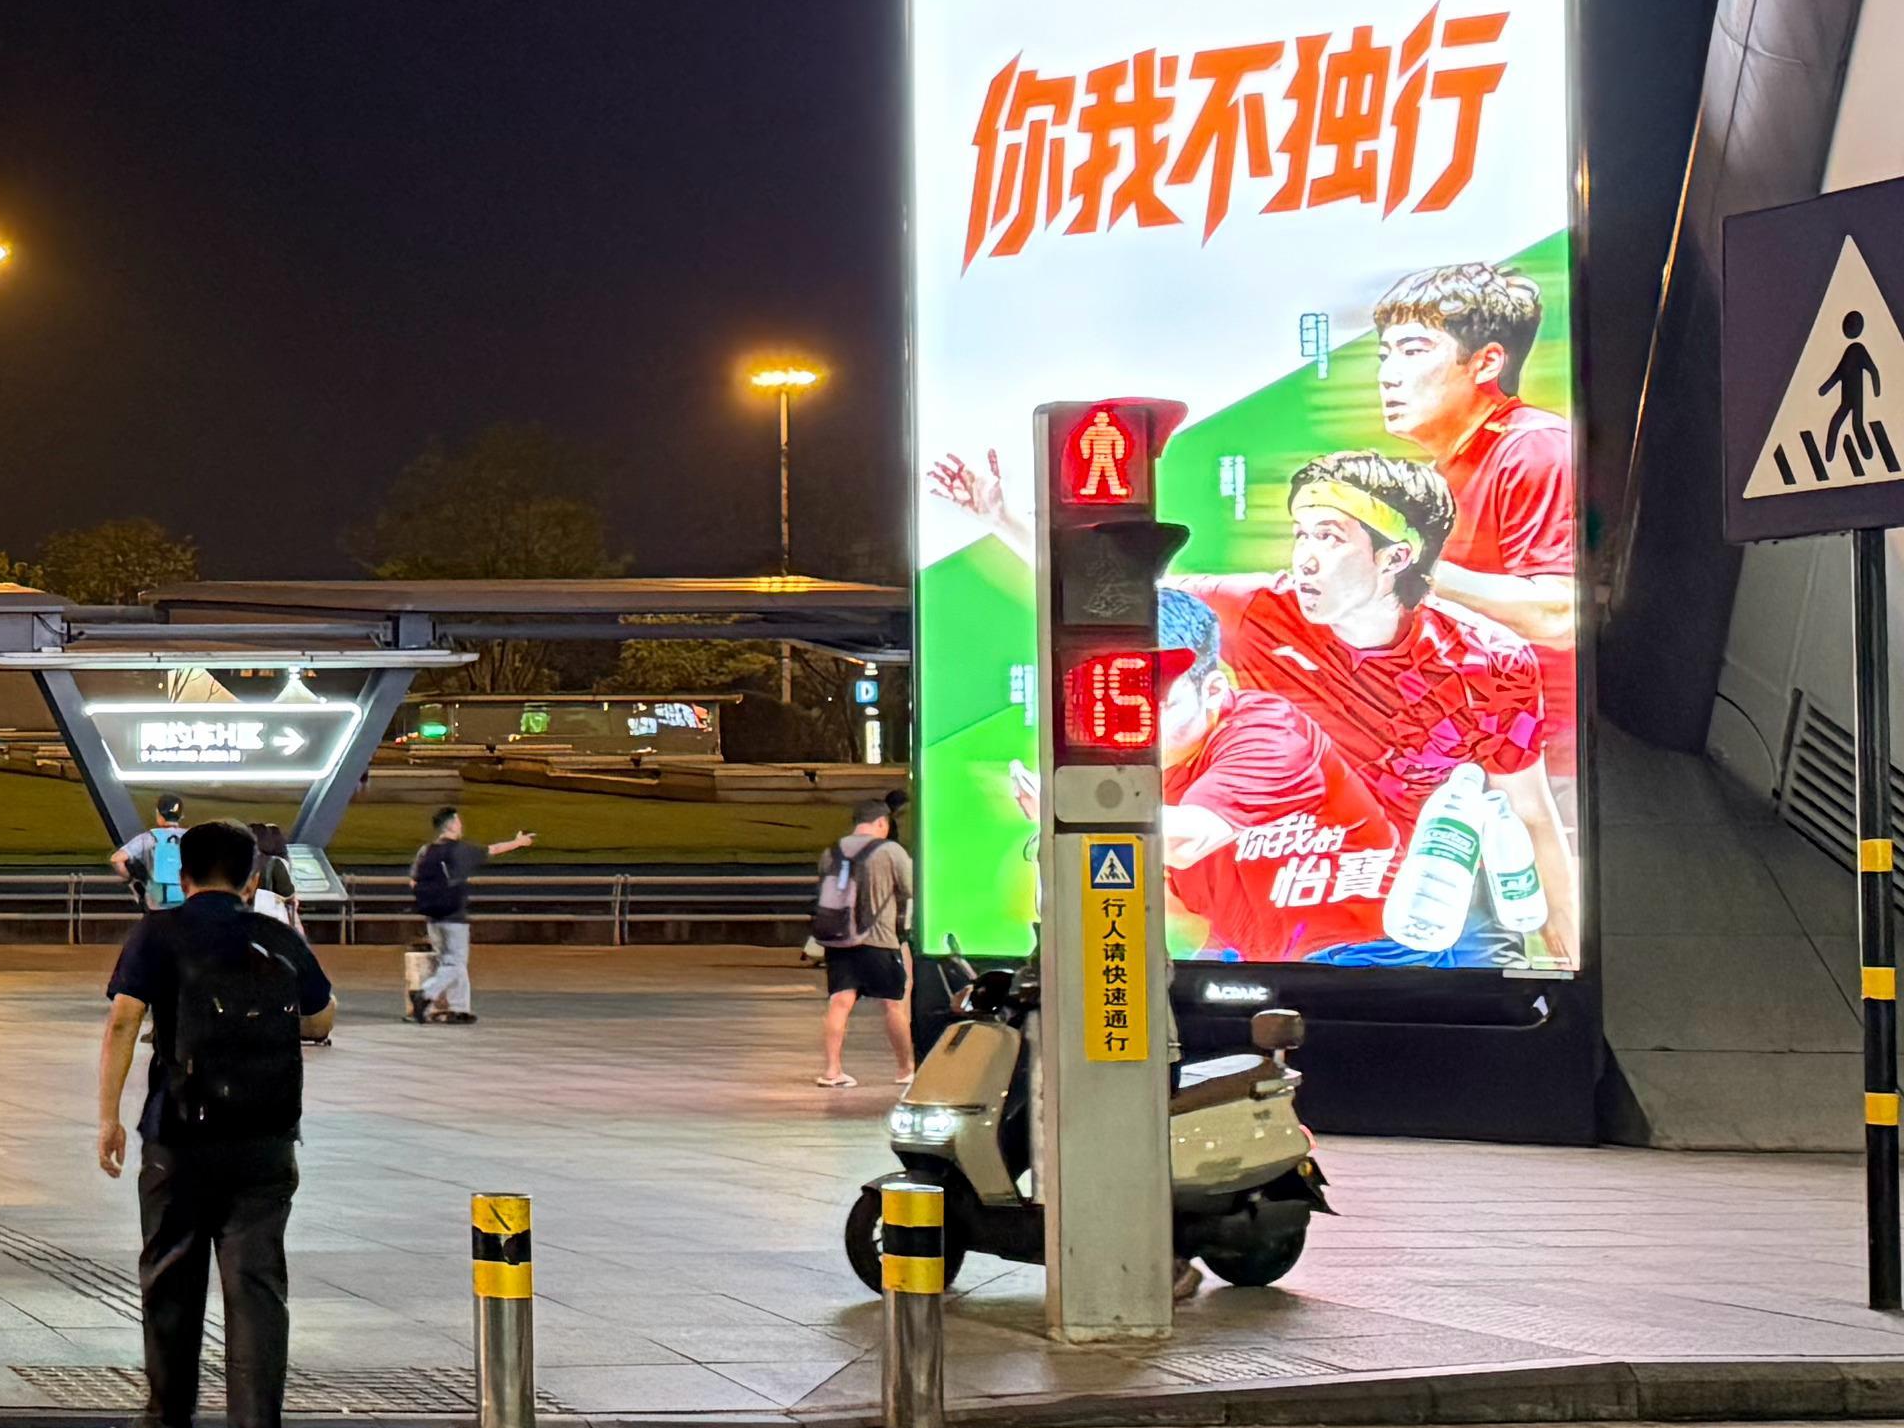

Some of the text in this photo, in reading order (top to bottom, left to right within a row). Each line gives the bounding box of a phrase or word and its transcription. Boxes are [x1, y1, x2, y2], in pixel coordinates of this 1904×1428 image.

[1093, 657, 1152, 744] 15
[1235, 812, 1346, 861] 你我的
[1102, 898, 1129, 1052] 行人请快速通行
